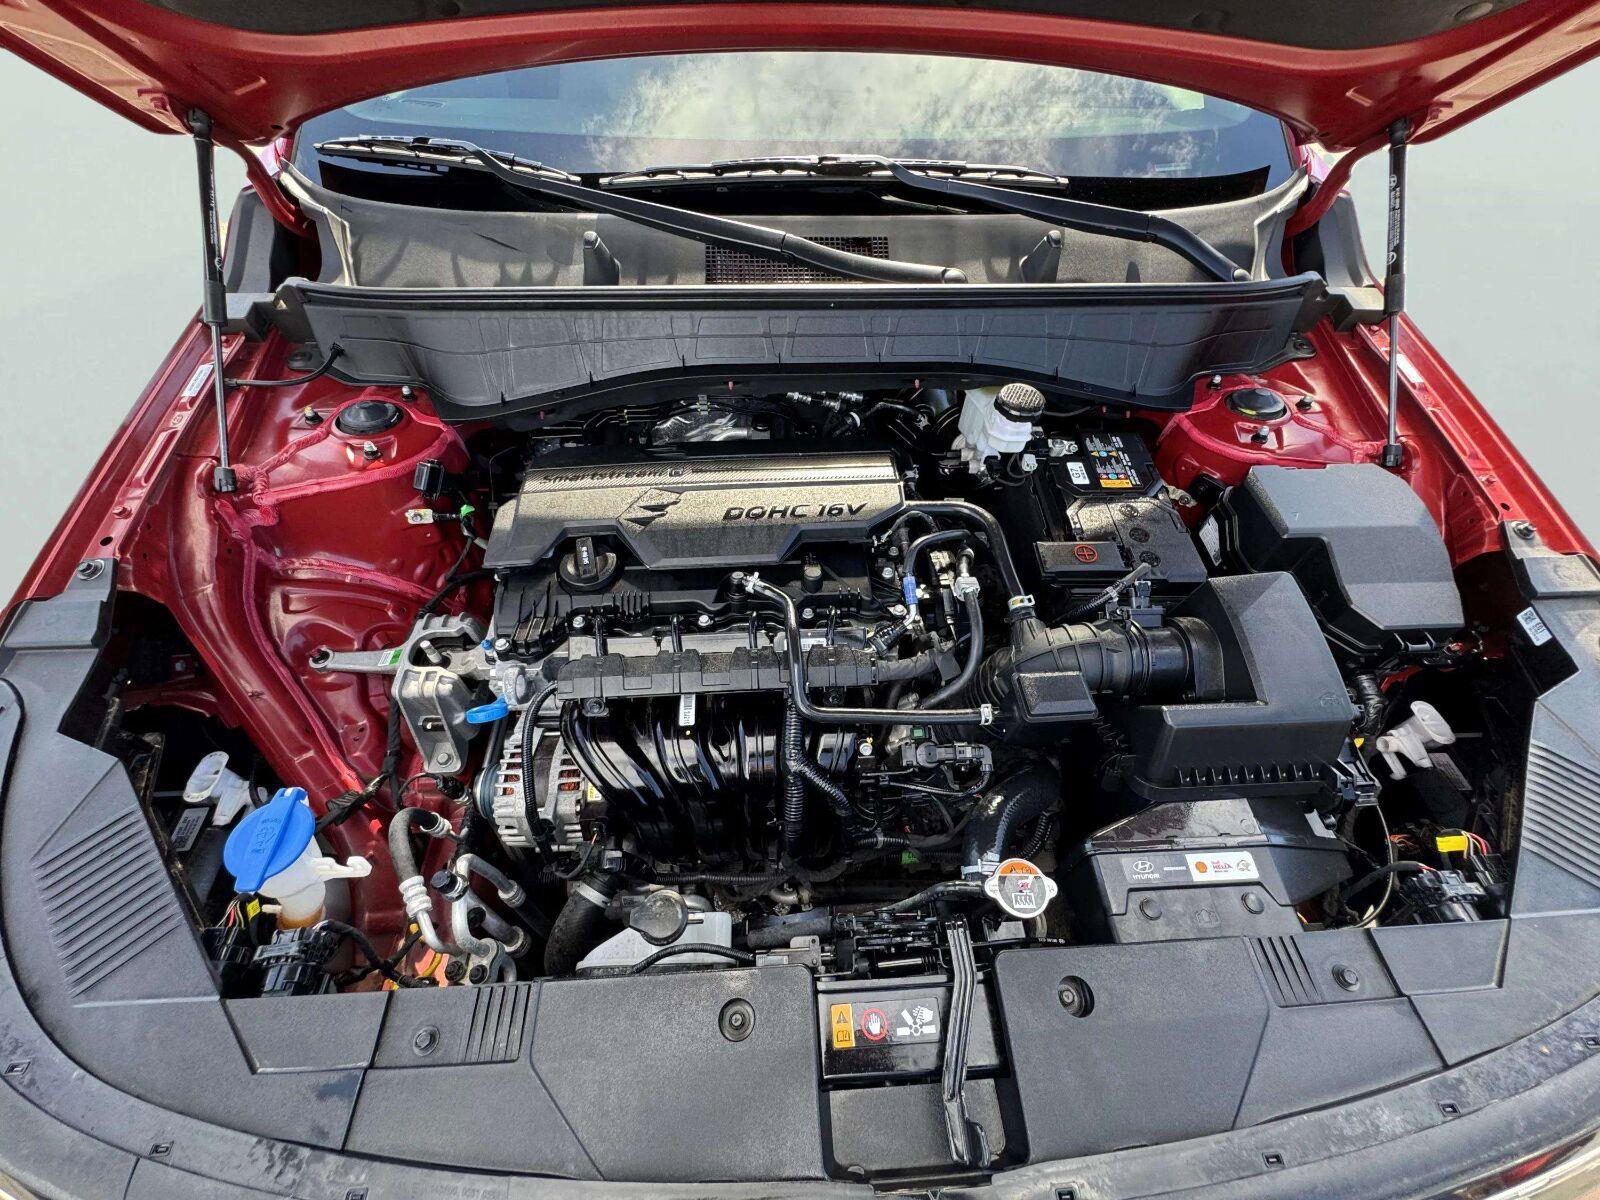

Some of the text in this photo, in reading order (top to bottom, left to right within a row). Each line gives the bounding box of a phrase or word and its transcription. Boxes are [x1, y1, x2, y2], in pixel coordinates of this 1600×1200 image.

[542, 469, 666, 483] Smartstream
[723, 502, 869, 521] DOHC 16V
